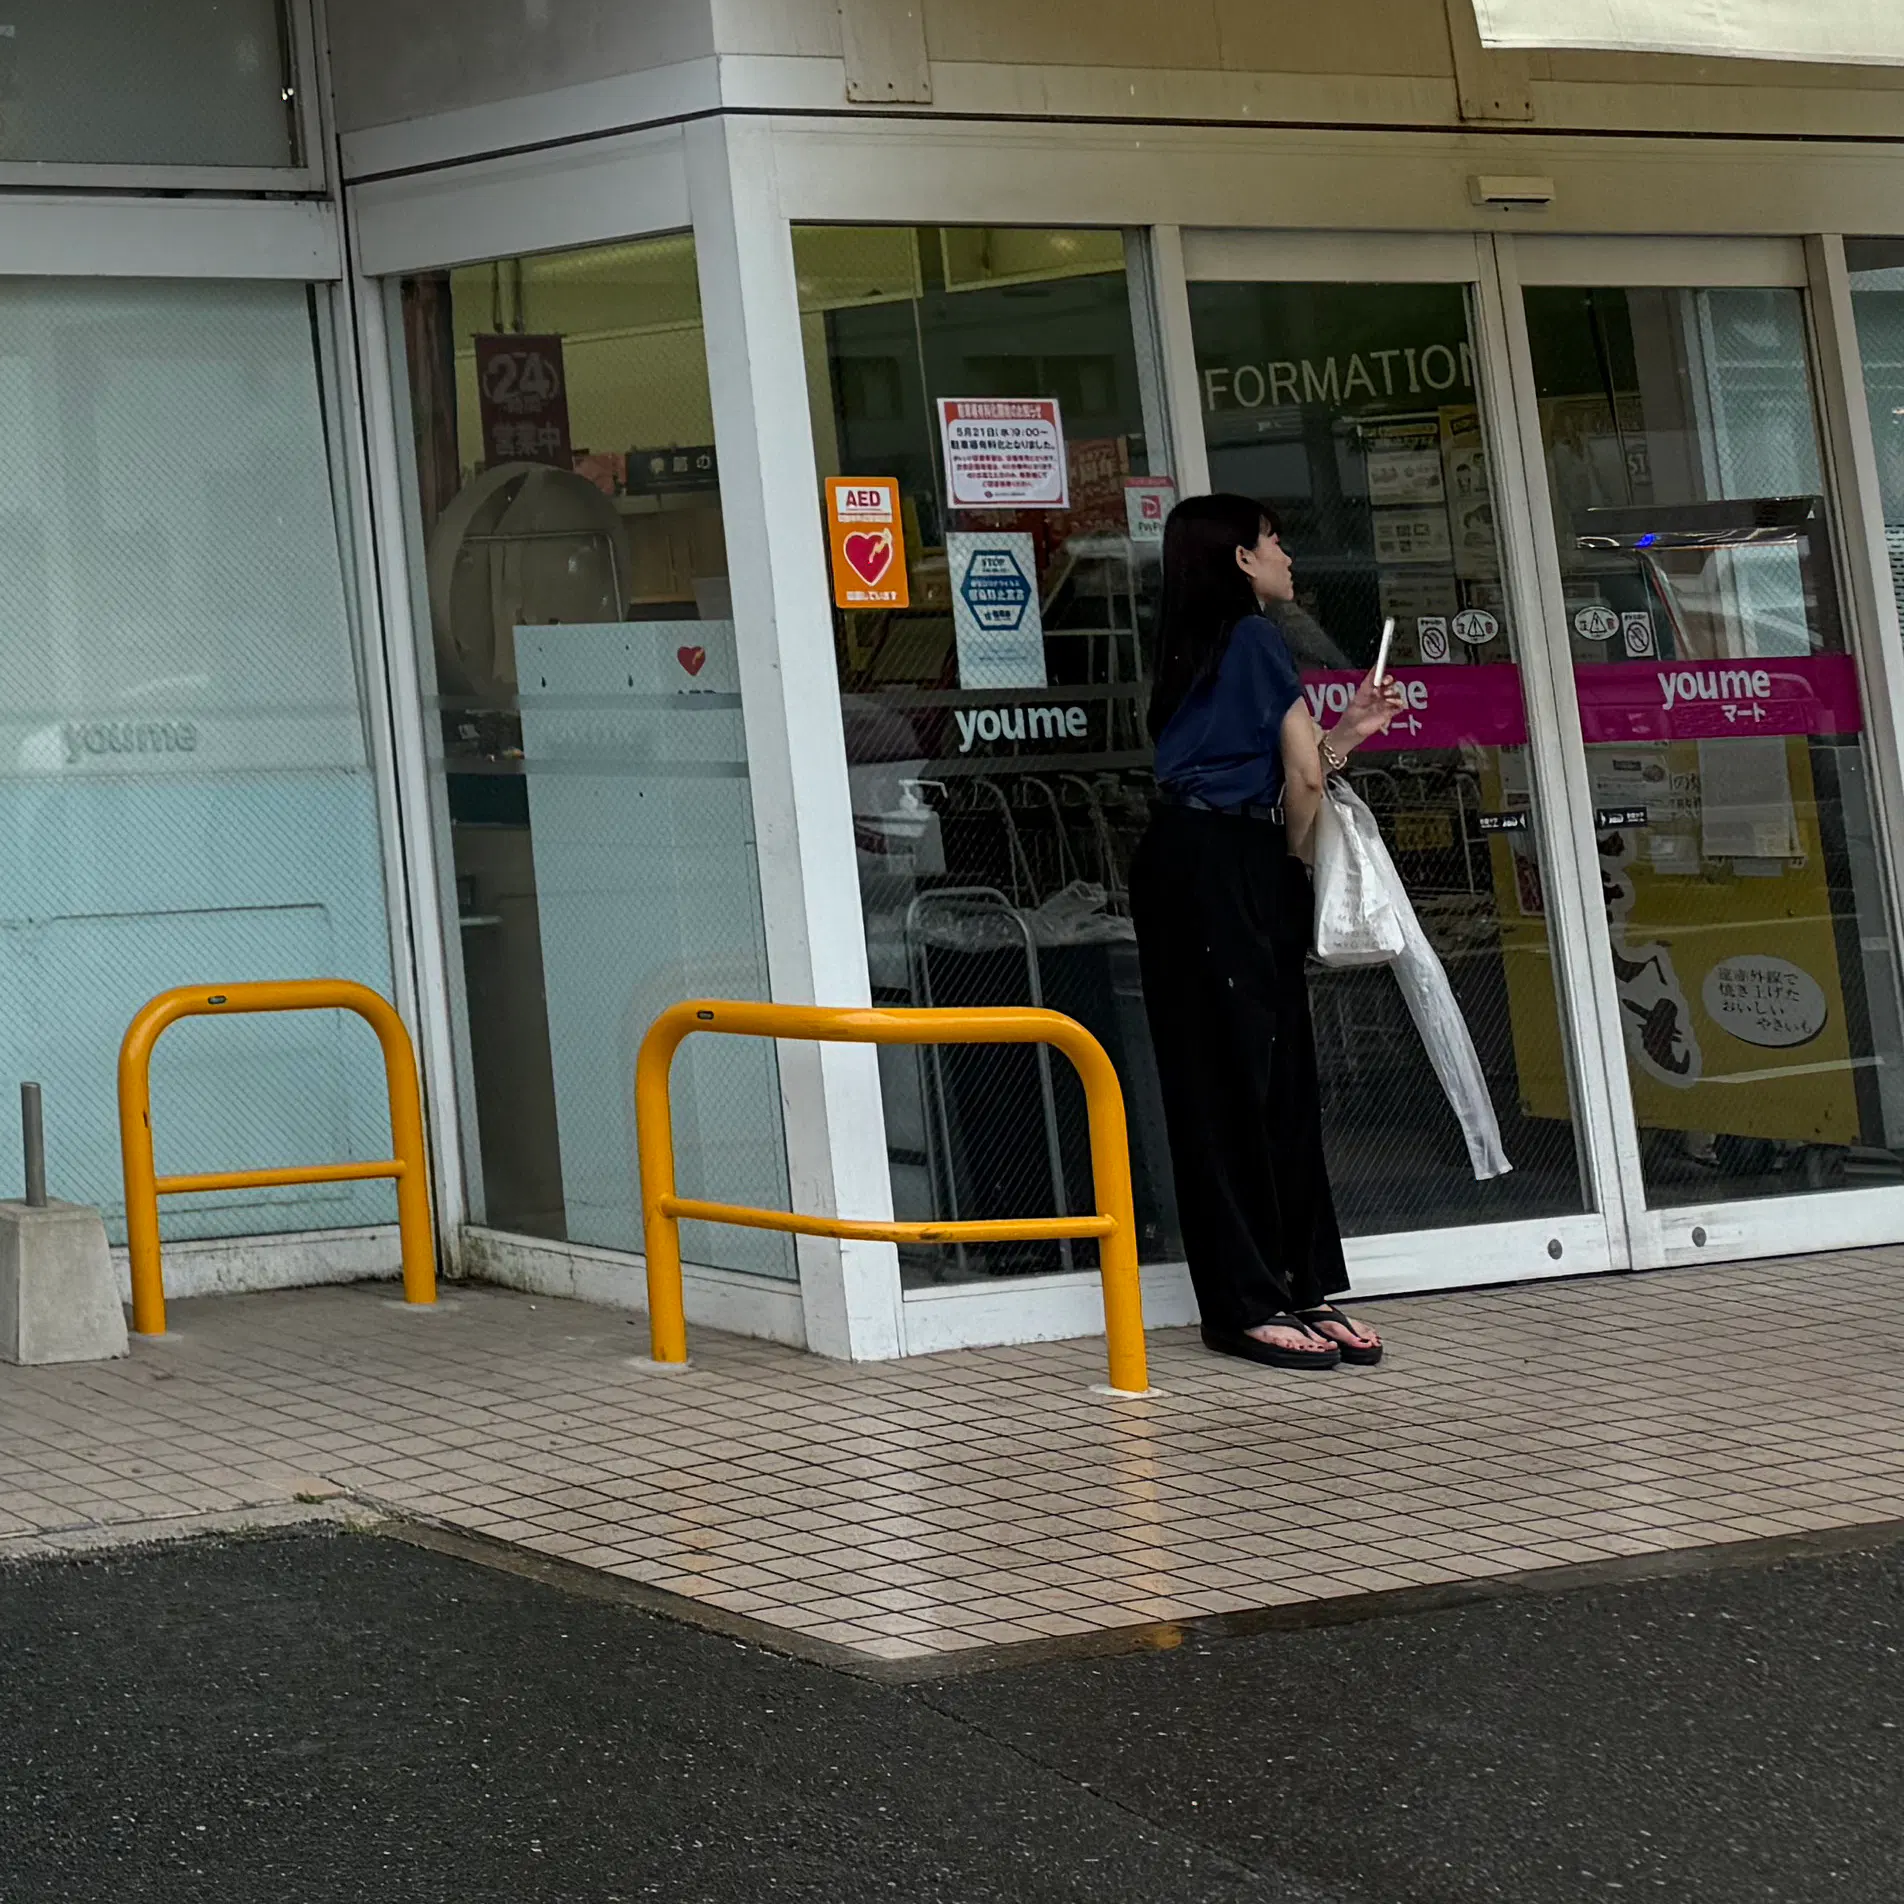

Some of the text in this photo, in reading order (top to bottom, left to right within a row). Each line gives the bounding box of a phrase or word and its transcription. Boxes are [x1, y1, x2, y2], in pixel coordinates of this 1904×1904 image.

[846, 489, 882, 507] AED
[1305, 680, 1429, 720] yoe
[1657, 667, 1771, 711] youme
[954, 702, 1088, 753] youme
[1721, 702, 1767, 723] マート
[64, 720, 197, 764] youme
[1722, 1001, 1785, 1015] おいしい
